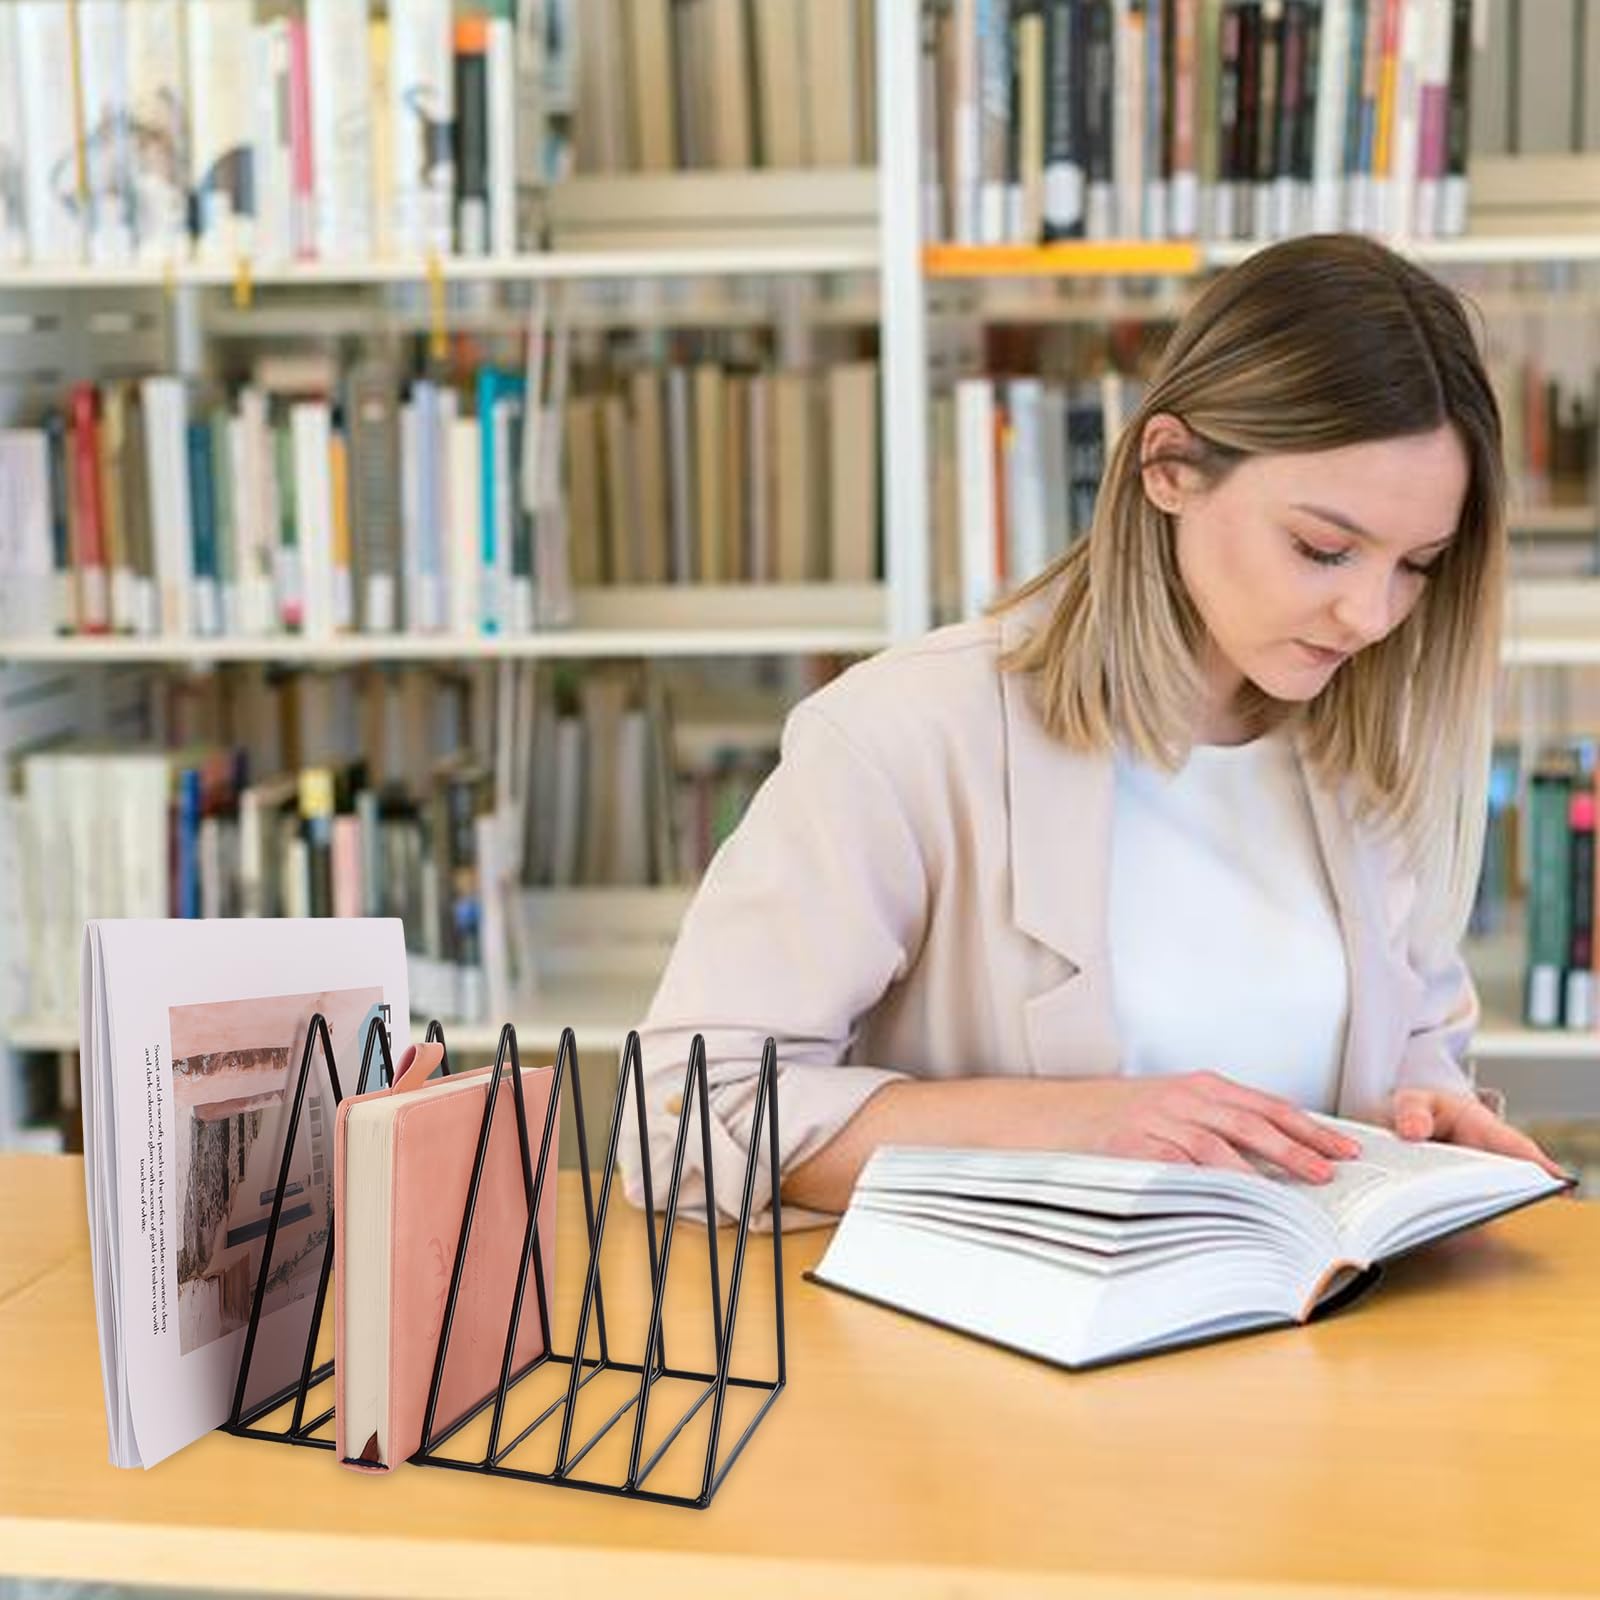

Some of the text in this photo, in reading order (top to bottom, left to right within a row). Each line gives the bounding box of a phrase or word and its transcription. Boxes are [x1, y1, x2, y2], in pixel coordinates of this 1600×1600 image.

[140, 1195, 148, 1206] of
[150, 1222, 157, 1232] of
[149, 1233, 157, 1252] gold
[152, 1254, 156, 1264] or
[160, 1266, 165, 1276] to
[152, 1300, 157, 1314] up
